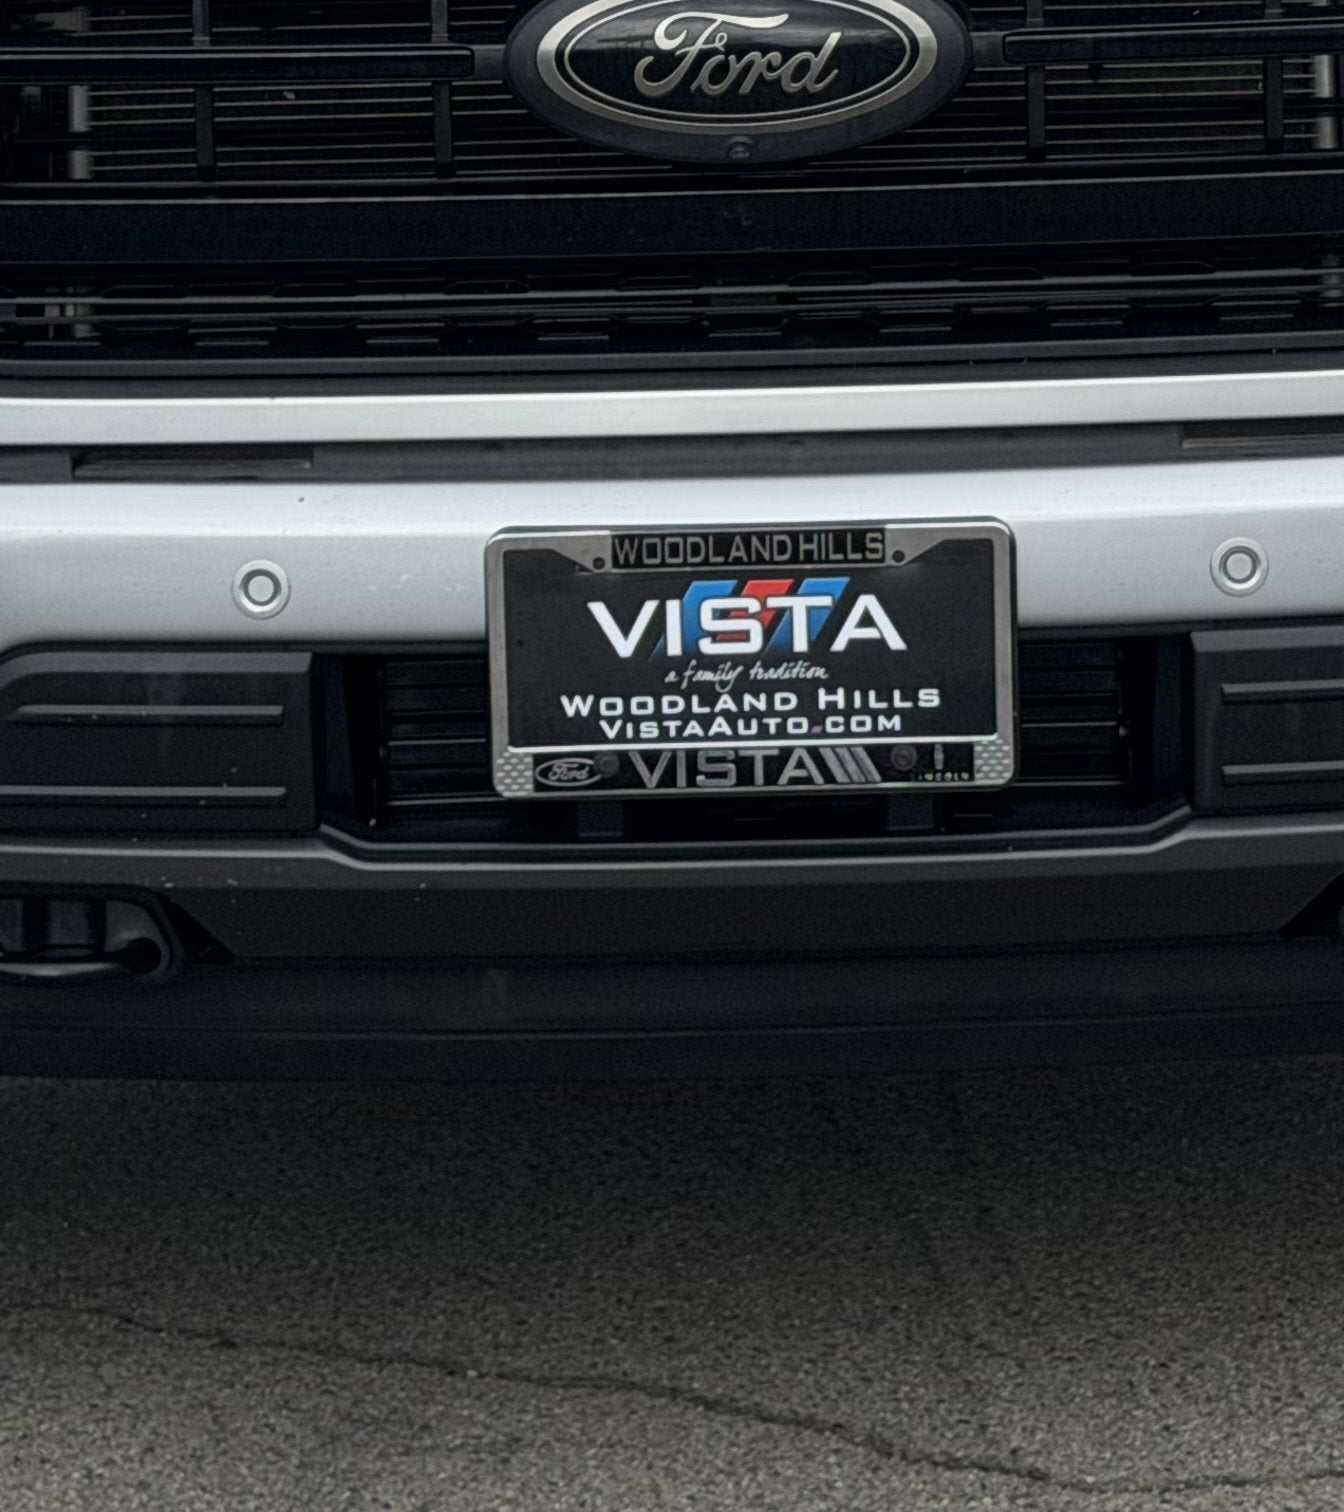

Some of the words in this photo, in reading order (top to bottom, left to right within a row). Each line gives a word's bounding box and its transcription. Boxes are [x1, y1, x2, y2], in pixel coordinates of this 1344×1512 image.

[633, 10, 843, 99] Ford
[613, 532, 794, 565] WOODLAND
[798, 530, 884, 561] HILLS
[586, 593, 908, 658] VISTA
[664, 670, 679, 683] a
[680, 659, 744, 693] family
[749, 659, 830, 681] tradition
[560, 690, 798, 718] WOODLAND
[818, 687, 941, 709] HILLS
[547, 762, 591, 781] Ford
[628, 745, 825, 789] VISTA
